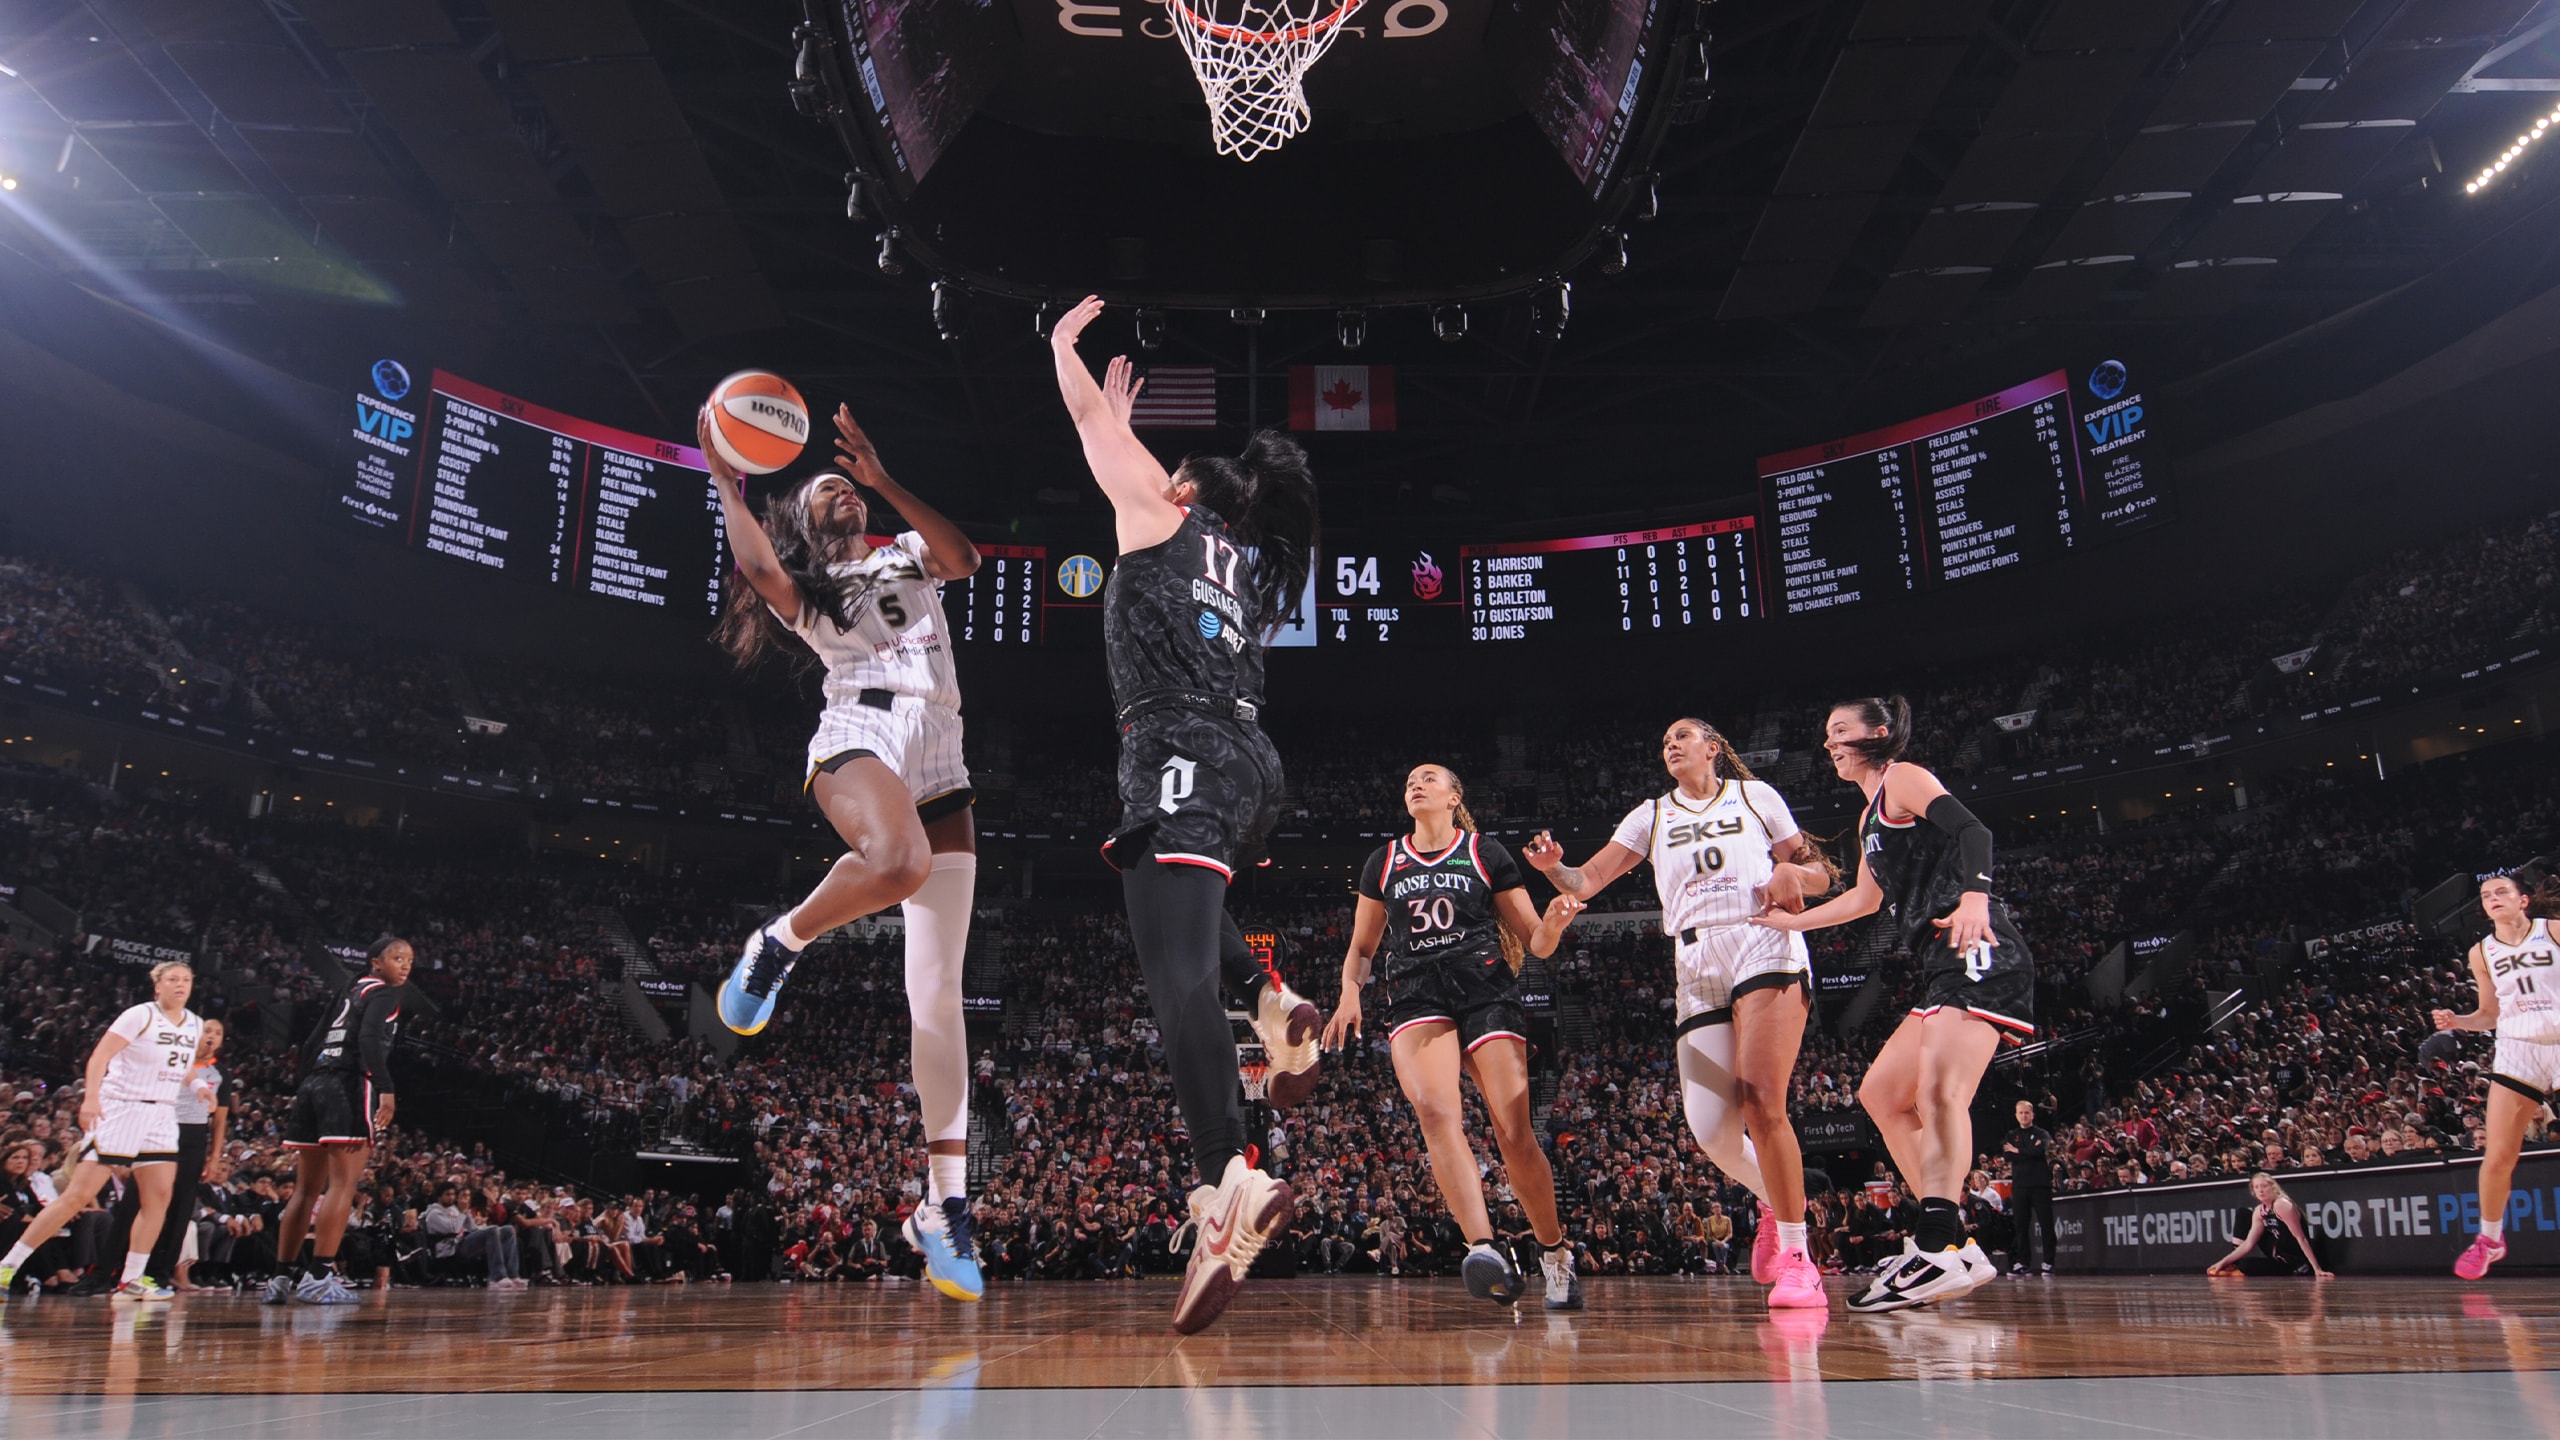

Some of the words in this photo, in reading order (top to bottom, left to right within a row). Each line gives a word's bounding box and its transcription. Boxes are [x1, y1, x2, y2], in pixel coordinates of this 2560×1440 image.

[357, 393, 416, 423] EXPERIENCE
[446, 400, 468, 416] FIELD
[468, 408, 487, 423] GOAL
[1975, 397, 2001, 416] FIRE
[2033, 404, 2044, 415] 45
[2084, 394, 2142, 423] EXPERIENCE
[356, 403, 413, 443] VIP
[445, 414, 476, 432] 3-POINT
[752, 401, 806, 437] Wilson
[2035, 417, 2045, 429] 38
[2086, 405, 2143, 444] VIP
[352, 429, 410, 456] TREATMENT
[442, 427, 462, 442] FREE
[463, 434, 490, 451] THROW
[1928, 435, 1949, 448] FIELD
[1950, 430, 1969, 443] GOAL
[2037, 431, 2047, 442] 77
[2049, 441, 2058, 451] 16
[2091, 430, 2146, 456] TREATMENT
[368, 454, 387, 467] FIRE
[441, 441, 481, 462] REBOUNDS
[1930, 445, 1959, 462] 3-POINT
[2051, 455, 2061, 465] 13
[2112, 455, 2130, 466] FIRE
[357, 460, 394, 480] BLAZERS
[438, 455, 470, 473] ASSISTS
[1931, 461, 1950, 474] FREE
[1951, 454, 1977, 468] THROW
[2057, 468, 2062, 478] 5
[2104, 462, 2141, 479] BLAZERS
[357, 471, 392, 489] THORNS
[437, 468, 466, 486] STEALS
[1933, 469, 1972, 487] REBOUNDS
[2059, 481, 2065, 491] 4
[2107, 472, 2142, 488] THORNS
[356, 480, 391, 500] TIMBERS
[435, 482, 465, 500] BLOCKS
[1935, 484, 1965, 500] ASSISTS
[2108, 481, 2144, 498] TIMBERS
[341, 496, 365, 510] First
[377, 507, 398, 521] Tech
[434, 496, 478, 517] TURNOVERS
[1936, 498, 1964, 514] STEALS
[2061, 496, 2066, 505] 7
[2102, 507, 2123, 520] First
[2136, 498, 2157, 510] Tech
[1938, 511, 1967, 527] BLOCKS
[2058, 510, 2068, 520] 26
[431, 510, 459, 527] POINTS
[459, 518, 469, 529] IN
[470, 521, 484, 534] THE
[485, 526, 508, 540] PAINT
[1613, 535, 1628, 544] PTS
[1643, 532, 1657, 541] REB
[1672, 528, 1687, 537] AST
[1702, 524, 1717, 533] BLK
[1730, 520, 1744, 529] FLS
[1940, 520, 1983, 539] TURNOVERS
[2060, 523, 2071, 534] 20
[429, 524, 456, 540] BENCH
[456, 532, 484, 548] POINTS
[1941, 538, 1968, 553] POINTS
[1968, 536, 1977, 546] IN
[1978, 531, 1993, 543] THE
[1993, 524, 2015, 539] PAINT
[2067, 537, 2073, 547] 2
[426, 538, 444, 551] 2ND
[444, 543, 475, 560] CHANCE
[476, 552, 504, 568] POINTS
[1472, 559, 1480, 573] 2
[1488, 556, 1543, 572] HARRISON
[1618, 549, 1626, 562] 0
[1647, 545, 1655, 559] 0
[1677, 541, 1685, 555] 3
[1707, 537, 1715, 552] 0
[1734, 533, 1742, 547] 2
[1943, 552, 1968, 567] BENCH
[1969, 544, 1996, 560] POINTS
[1201, 534, 1239, 597] 17
[1473, 576, 1481, 589] 3
[1488, 574, 1532, 589] BARKER
[1617, 566, 1630, 579] 11
[1649, 562, 1657, 576] 3
[1678, 559, 1686, 573] 0
[1708, 554, 1716, 568] 0
[1737, 551, 1743, 564] 1
[1944, 568, 1961, 580] 2ND
[1961, 560, 1991, 576] CHANCE
[1992, 552, 2019, 568] POINTS
[1337, 557, 1380, 596] 54
[1474, 593, 1482, 607] 6
[1489, 589, 1546, 606] CARLETON
[879, 594, 906, 627] 5
[1331, 609, 1350, 621] TOL
[1367, 608, 1399, 621] FOULS
[1472, 610, 1486, 624] 17
[1489, 606, 1553, 623] GUSTAFSON
[1221, 623, 1246, 653] AT&T
[1336, 624, 1346, 642] 4
[1379, 624, 1389, 642] 2
[1472, 627, 1487, 641] 30
[1491, 625, 1525, 640] JONES
[2461, 670, 2480, 680] FIRST
[2485, 663, 2502, 672] TECH
[2510, 649, 2540, 664] MEMBERS
[2301, 712, 2318, 721] FIRST
[2324, 706, 2341, 715] TECH
[2350, 696, 2382, 708] MEMBERS
[2178, 743, 2195, 751] TECH
[1667, 816, 1745, 848] SKY
[1447, 858, 1471, 866] chime
[1693, 847, 1724, 875] 10
[1394, 874, 1430, 899] ROSE
[1433, 873, 1472, 893] CITY
[1408, 897, 1455, 934] 30
[1245, 934, 1275, 948] 4:44
[1410, 931, 1466, 951] LASHIFY
[112, 938, 152, 956] PACIFIC
[154, 946, 191, 964] OFFICE
[2494, 950, 2554, 977] SKY
[640, 981, 657, 989] First
[2517, 974, 2536, 995] 11
[157, 1032, 195, 1049] SKY
[168, 1051, 189, 1068] 24
[1804, 1125, 1824, 1136] First
[1834, 1122, 1854, 1135] Tech
[2103, 1215, 2139, 1246] THE
[2142, 1210, 2214, 1244] CREDIT
[2307, 1203, 2362, 1239] FOR
[2373, 1197, 2431, 1237] THE
[2438, 1186, 2560, 1234] PEPL
[2064, 1220, 2082, 1235] Tech
